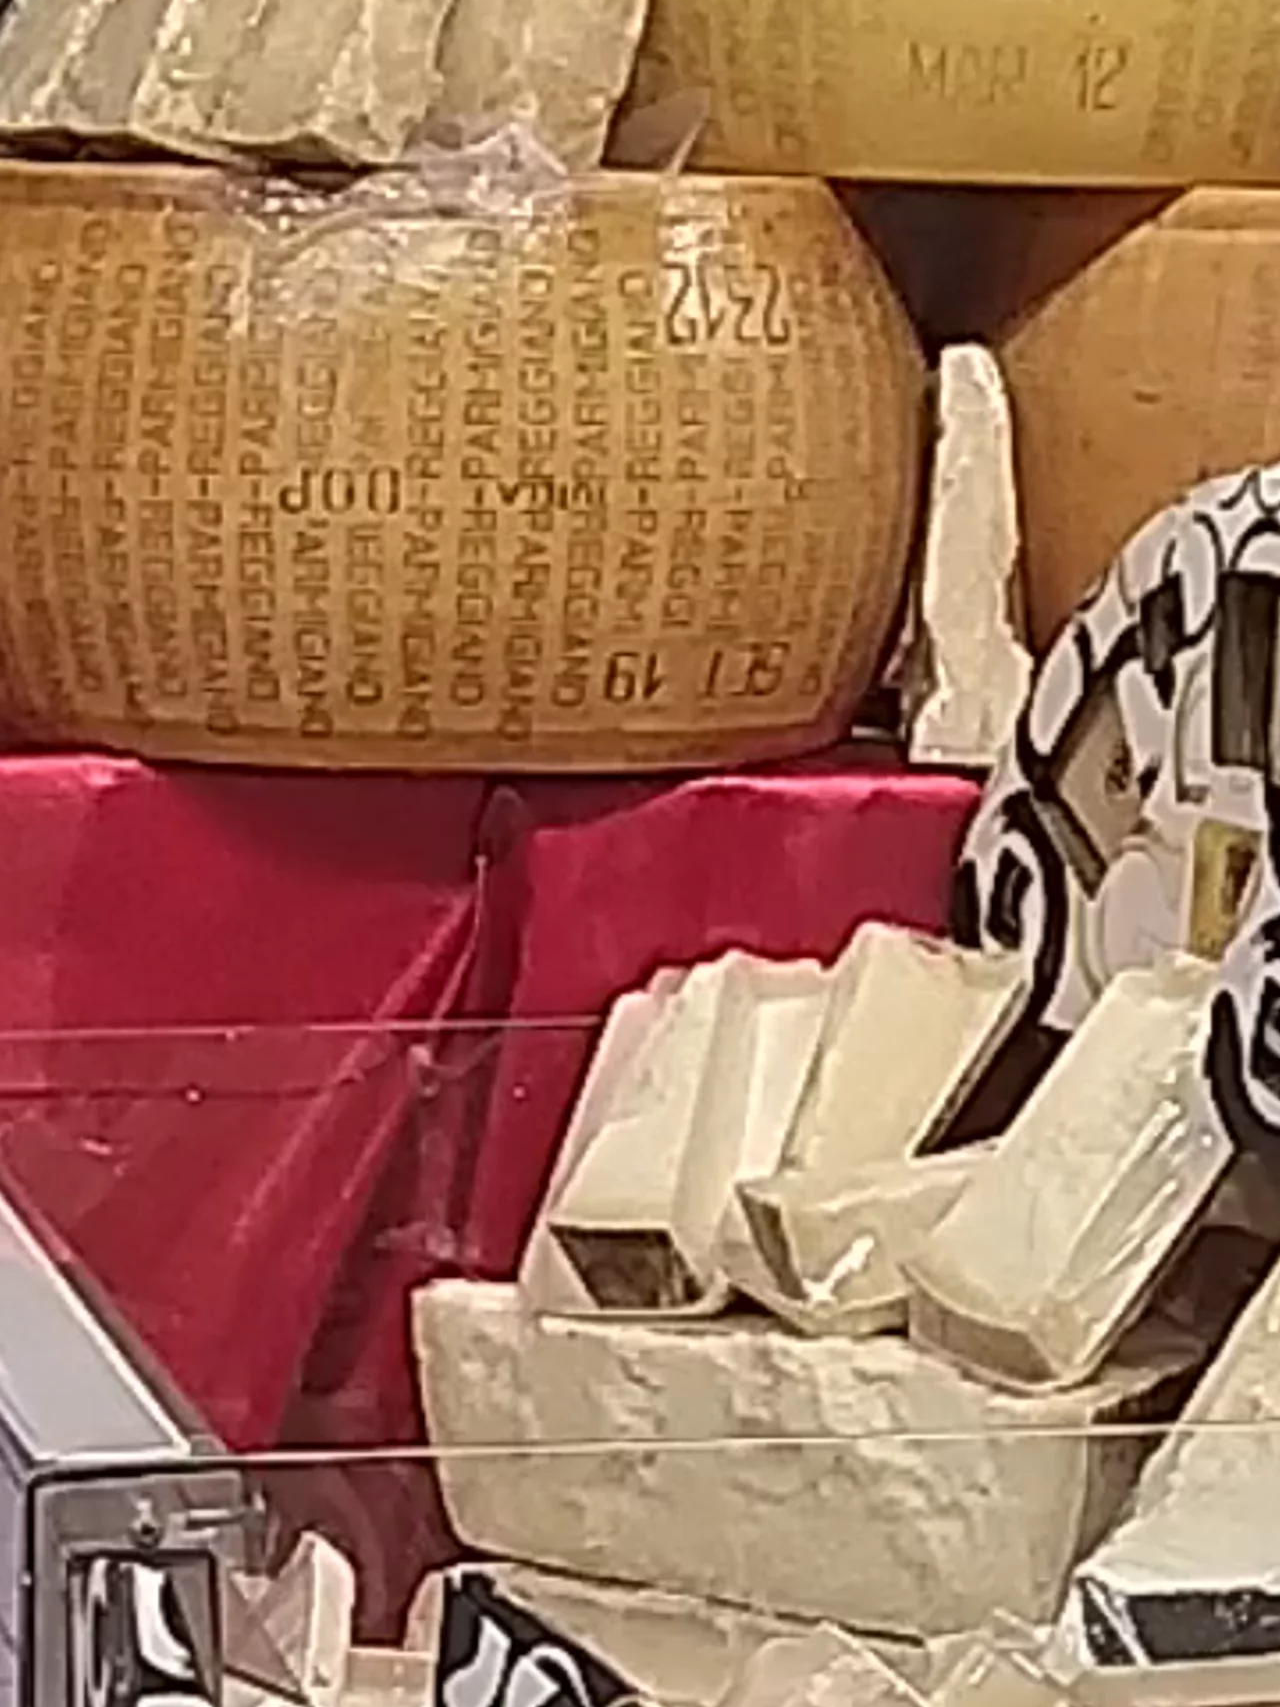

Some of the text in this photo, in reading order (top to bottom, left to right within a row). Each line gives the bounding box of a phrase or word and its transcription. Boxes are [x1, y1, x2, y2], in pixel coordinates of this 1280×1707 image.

[1076, 42, 1130, 113] 12
[277, 464, 403, 515] DOP
[603, 649, 666, 696] 19
